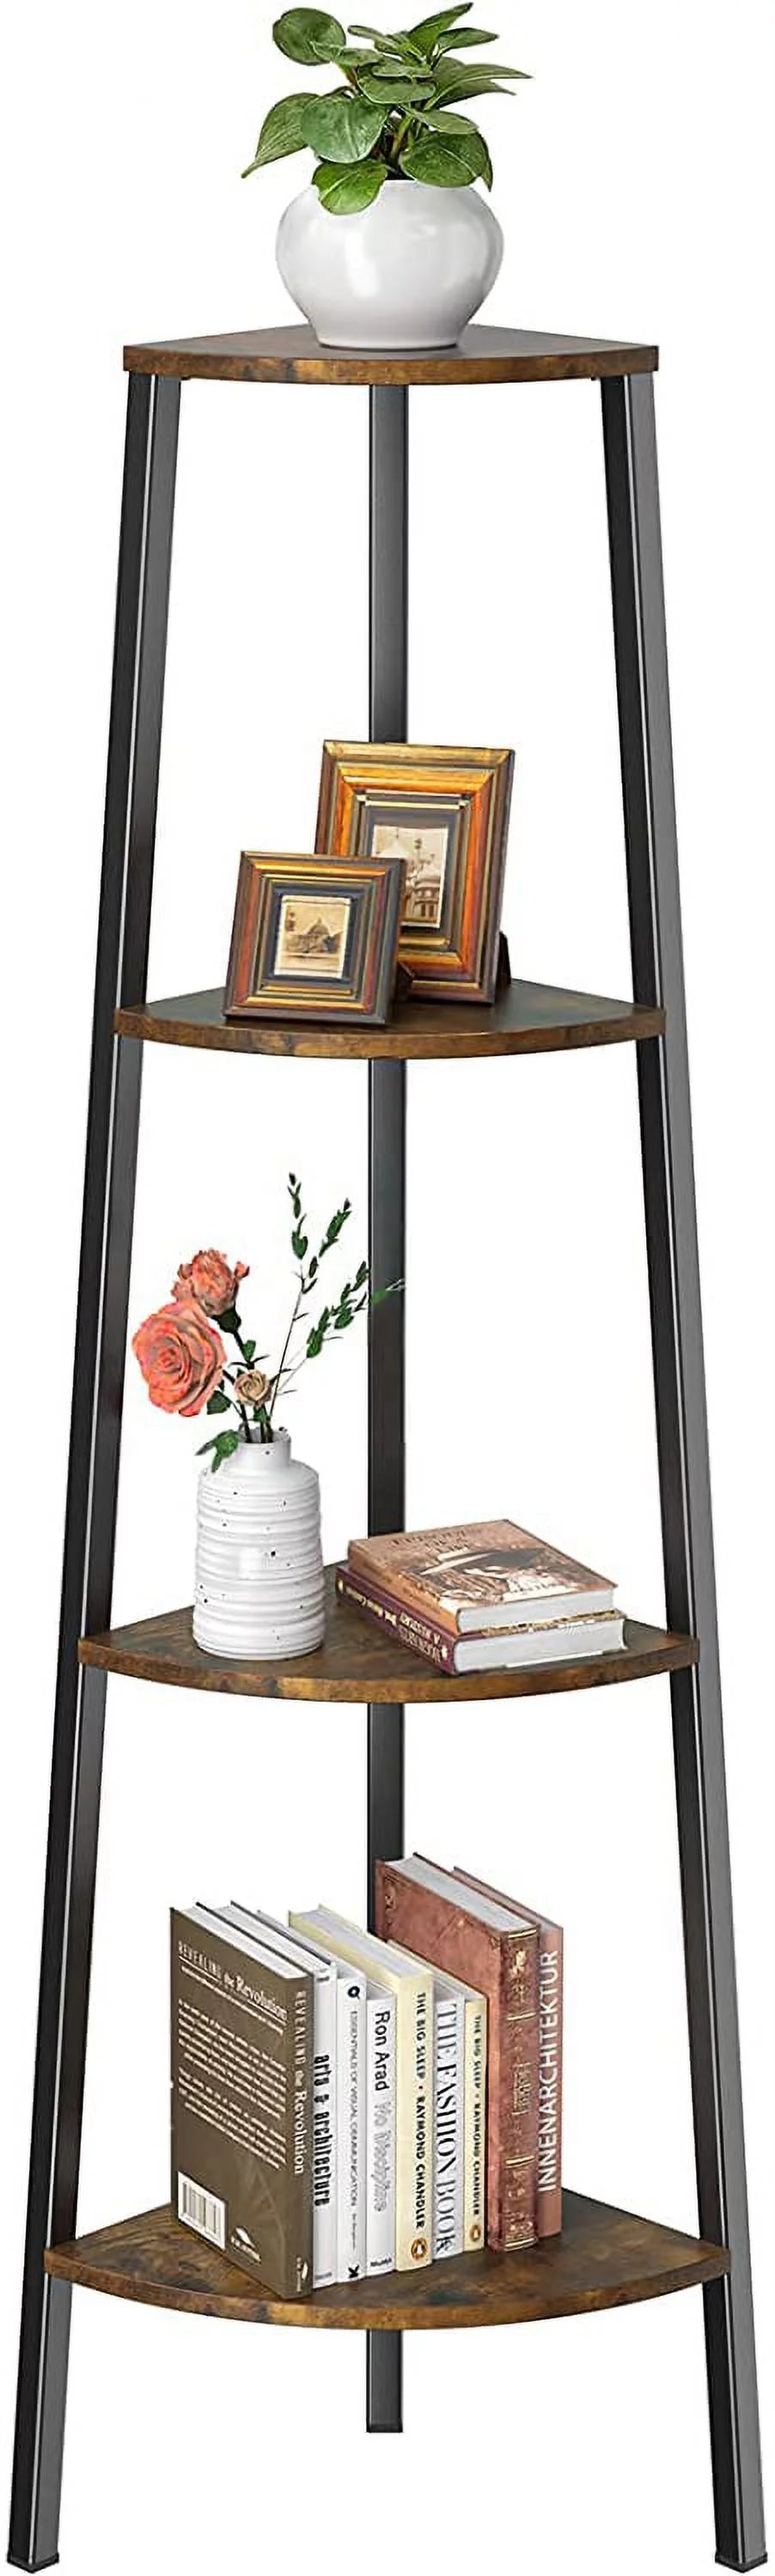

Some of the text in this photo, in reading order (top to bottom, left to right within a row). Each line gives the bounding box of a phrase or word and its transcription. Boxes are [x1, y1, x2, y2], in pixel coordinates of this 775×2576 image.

[237, 1974, 290, 2021] Revolution
[473, 2014, 482, 2034] THE
[375, 2010, 391, 2046] Ron
[314, 2054, 332, 2087] arts
[375, 2051, 391, 2092] Arad
[473, 2060, 482, 2089] SLEEP
[538, 1950, 558, 2191] INNENARCHITEKTUR
[294, 2090, 308, 2174] Revolution
[415, 1992, 426, 2229] THE BIG SLEEP RAYMOND CHANDLER
[436, 2002, 457, 2253] THE FASHION BOOK
[473, 2103, 482, 2158] RAYMOND
[314, 2111, 333, 2207] architecture
[473, 2160, 481, 2215] CHANDLER
